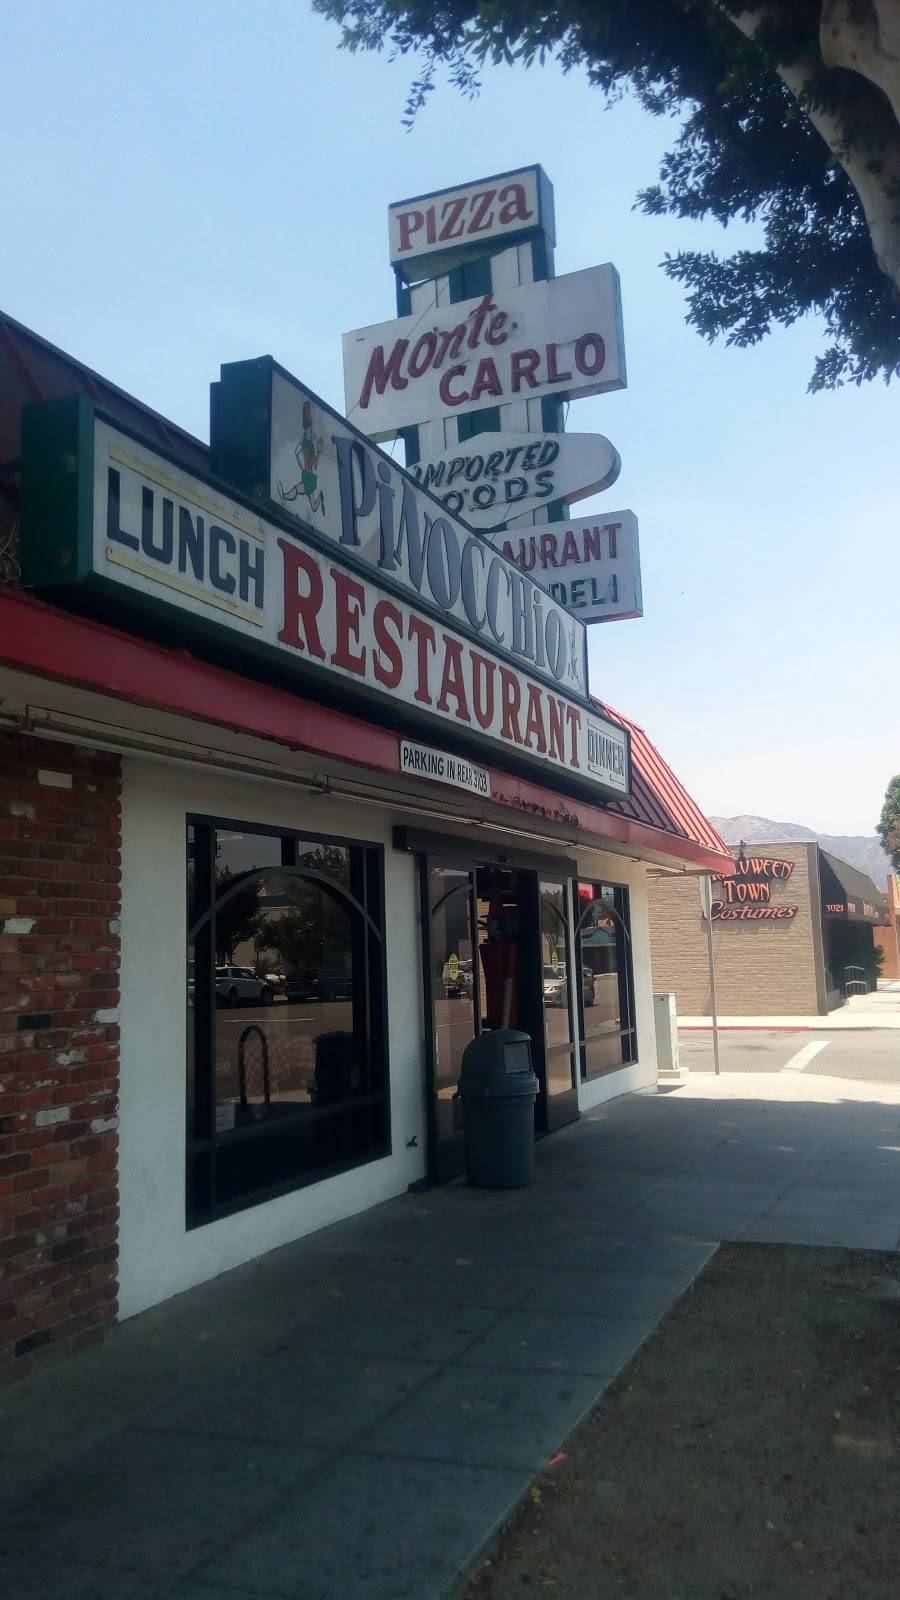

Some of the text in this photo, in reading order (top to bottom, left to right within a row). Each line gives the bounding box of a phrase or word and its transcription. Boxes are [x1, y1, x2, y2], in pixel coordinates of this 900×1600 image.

[360, 294, 508, 408] Monte
[439, 332, 606, 407] CARLO
[442, 470, 554, 513] OODS
[107, 467, 625, 776] LUNCH RESTAURANT DINNER
[403, 747, 445, 775] PARKING
[447, 760, 455, 779] IN
[457, 764, 472, 786] REAR
[711, 901, 796, 919] Costumes
